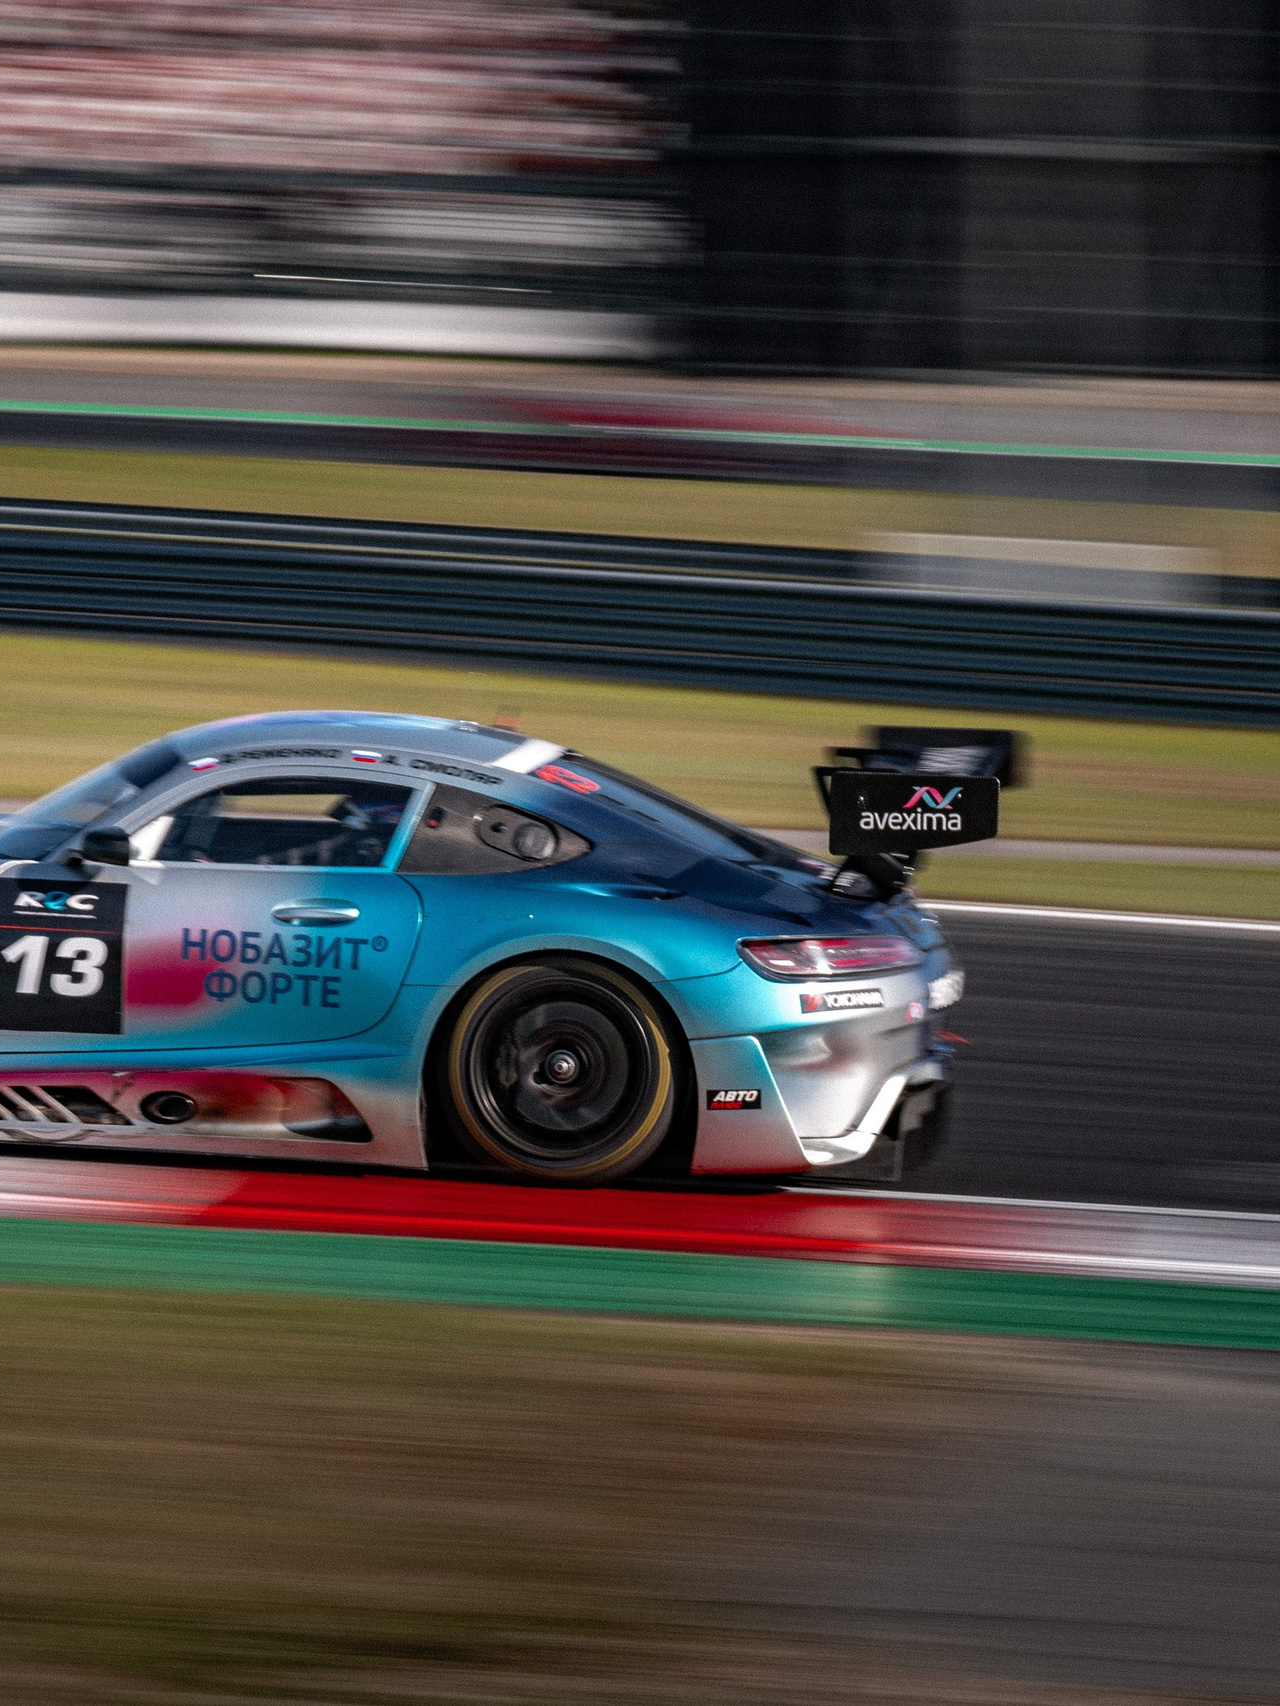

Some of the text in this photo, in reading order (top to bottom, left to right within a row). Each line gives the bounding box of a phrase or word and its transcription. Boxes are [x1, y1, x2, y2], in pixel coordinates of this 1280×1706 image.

[860, 808, 962, 831] avexima
[0, 935, 110, 998] 13
[204, 968, 341, 1008] ФОРТЕ
[712, 1090, 759, 1102] АВТО
